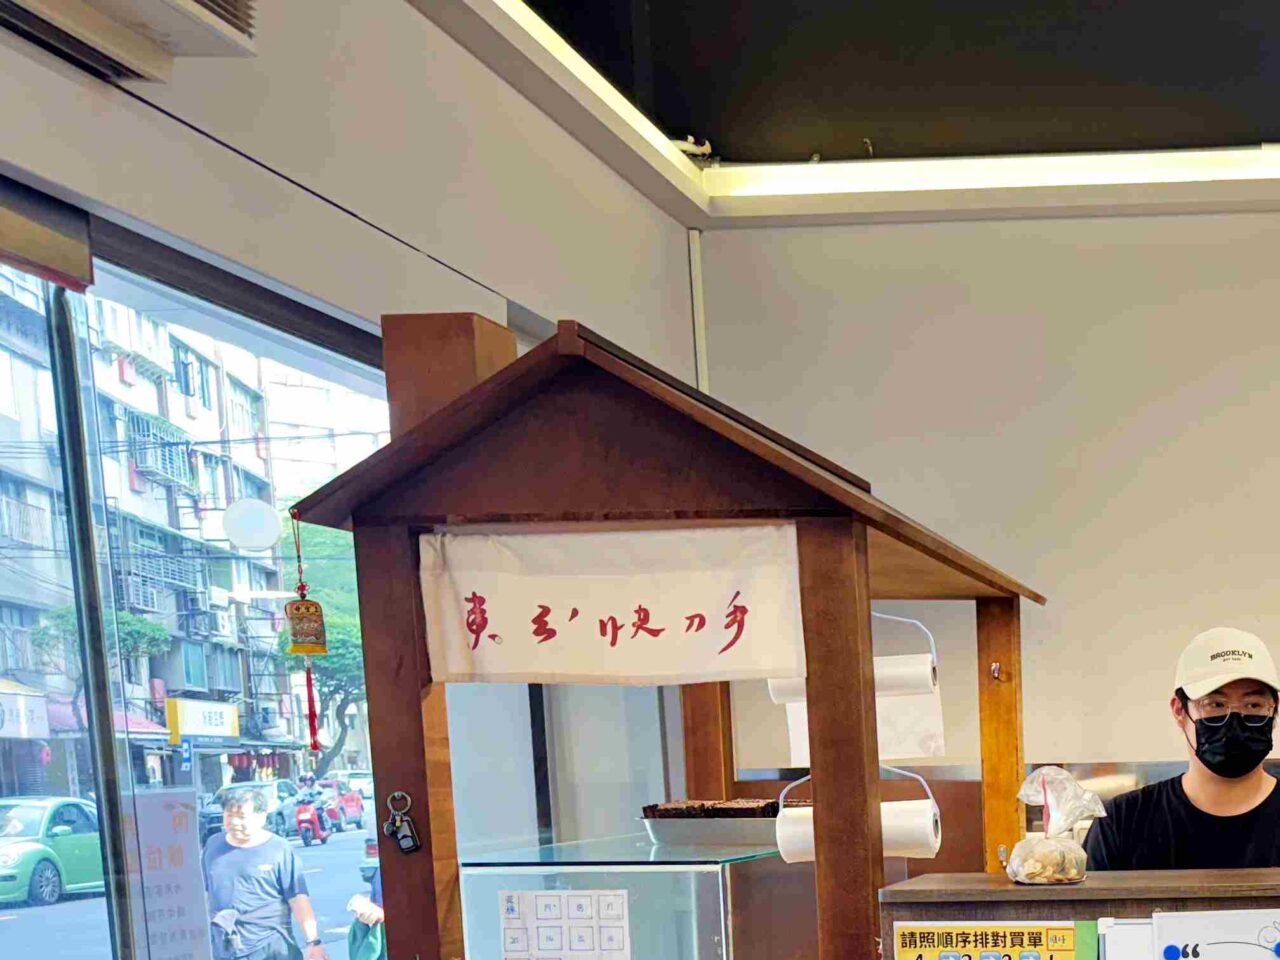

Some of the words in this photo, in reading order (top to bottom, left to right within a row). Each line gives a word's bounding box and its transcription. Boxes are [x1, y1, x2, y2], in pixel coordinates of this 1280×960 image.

[1209, 649, 1253, 661] BROOKLYN
[900, 931, 1044, 949] 請照順序排對買單
